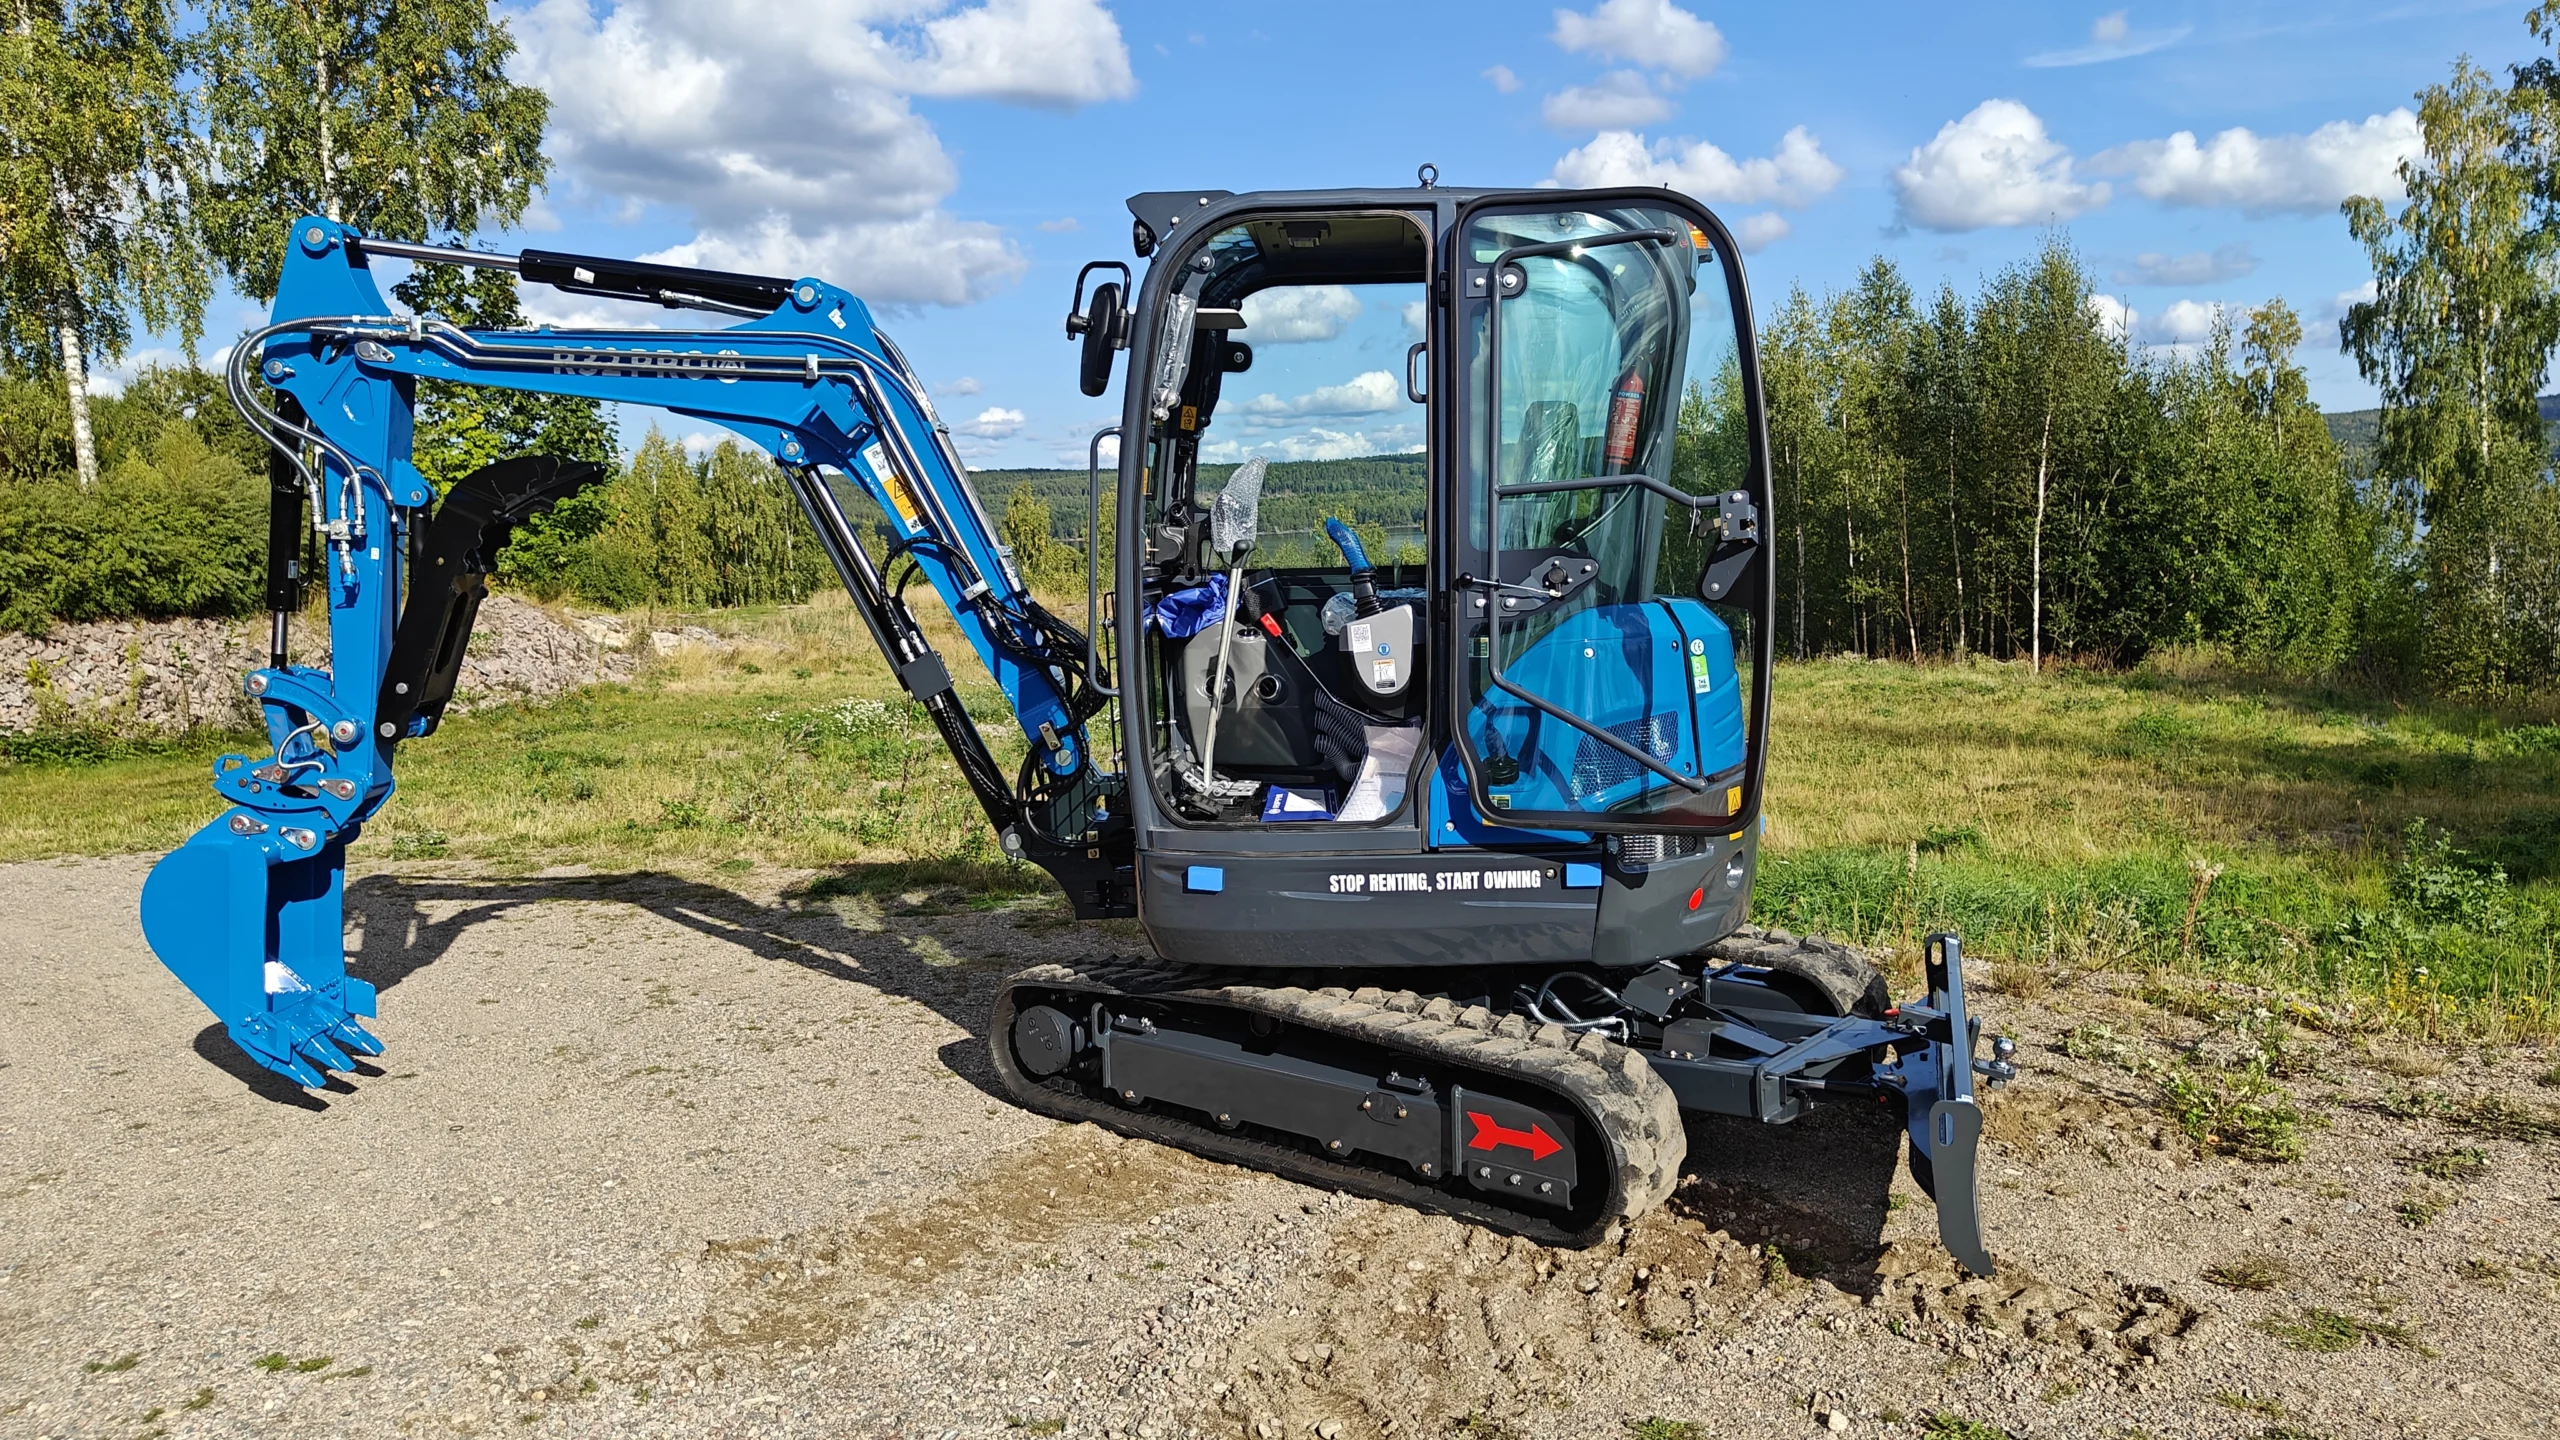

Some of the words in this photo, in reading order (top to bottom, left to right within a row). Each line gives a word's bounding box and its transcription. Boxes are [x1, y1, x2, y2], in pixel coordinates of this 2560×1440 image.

[1329, 874, 1365, 893] STOP
[1369, 872, 1432, 893] RENTING,
[1436, 871, 1480, 891] START
[1483, 869, 1542, 890] OWNING
